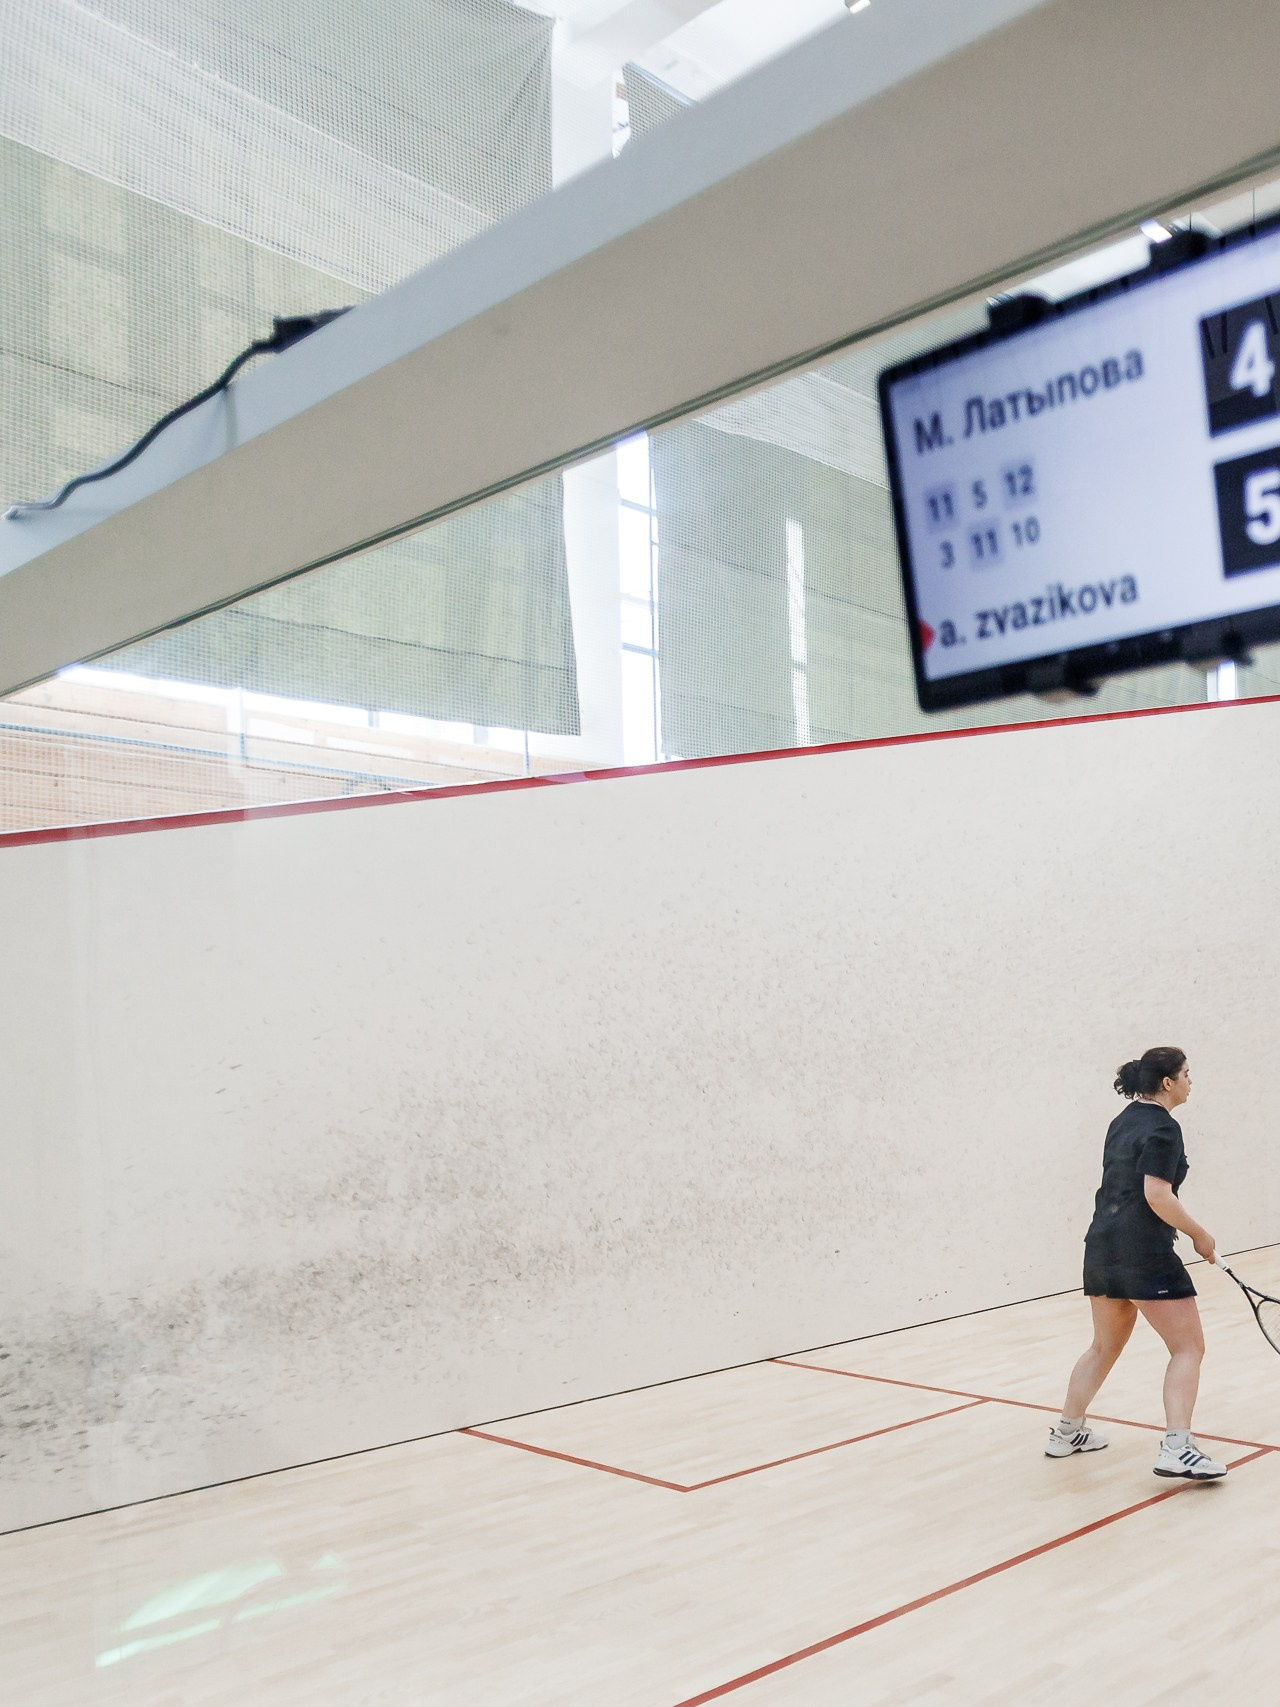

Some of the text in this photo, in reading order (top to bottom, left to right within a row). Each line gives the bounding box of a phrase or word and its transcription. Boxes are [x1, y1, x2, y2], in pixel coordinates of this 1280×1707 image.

[1230, 322, 1276, 398] 4
[914, 349, 1144, 455] М. Латыпова
[927, 464, 1034, 523] 11 5 12
[939, 516, 1041, 569] 3 11 10
[975, 573, 1140, 640] zvazikova
